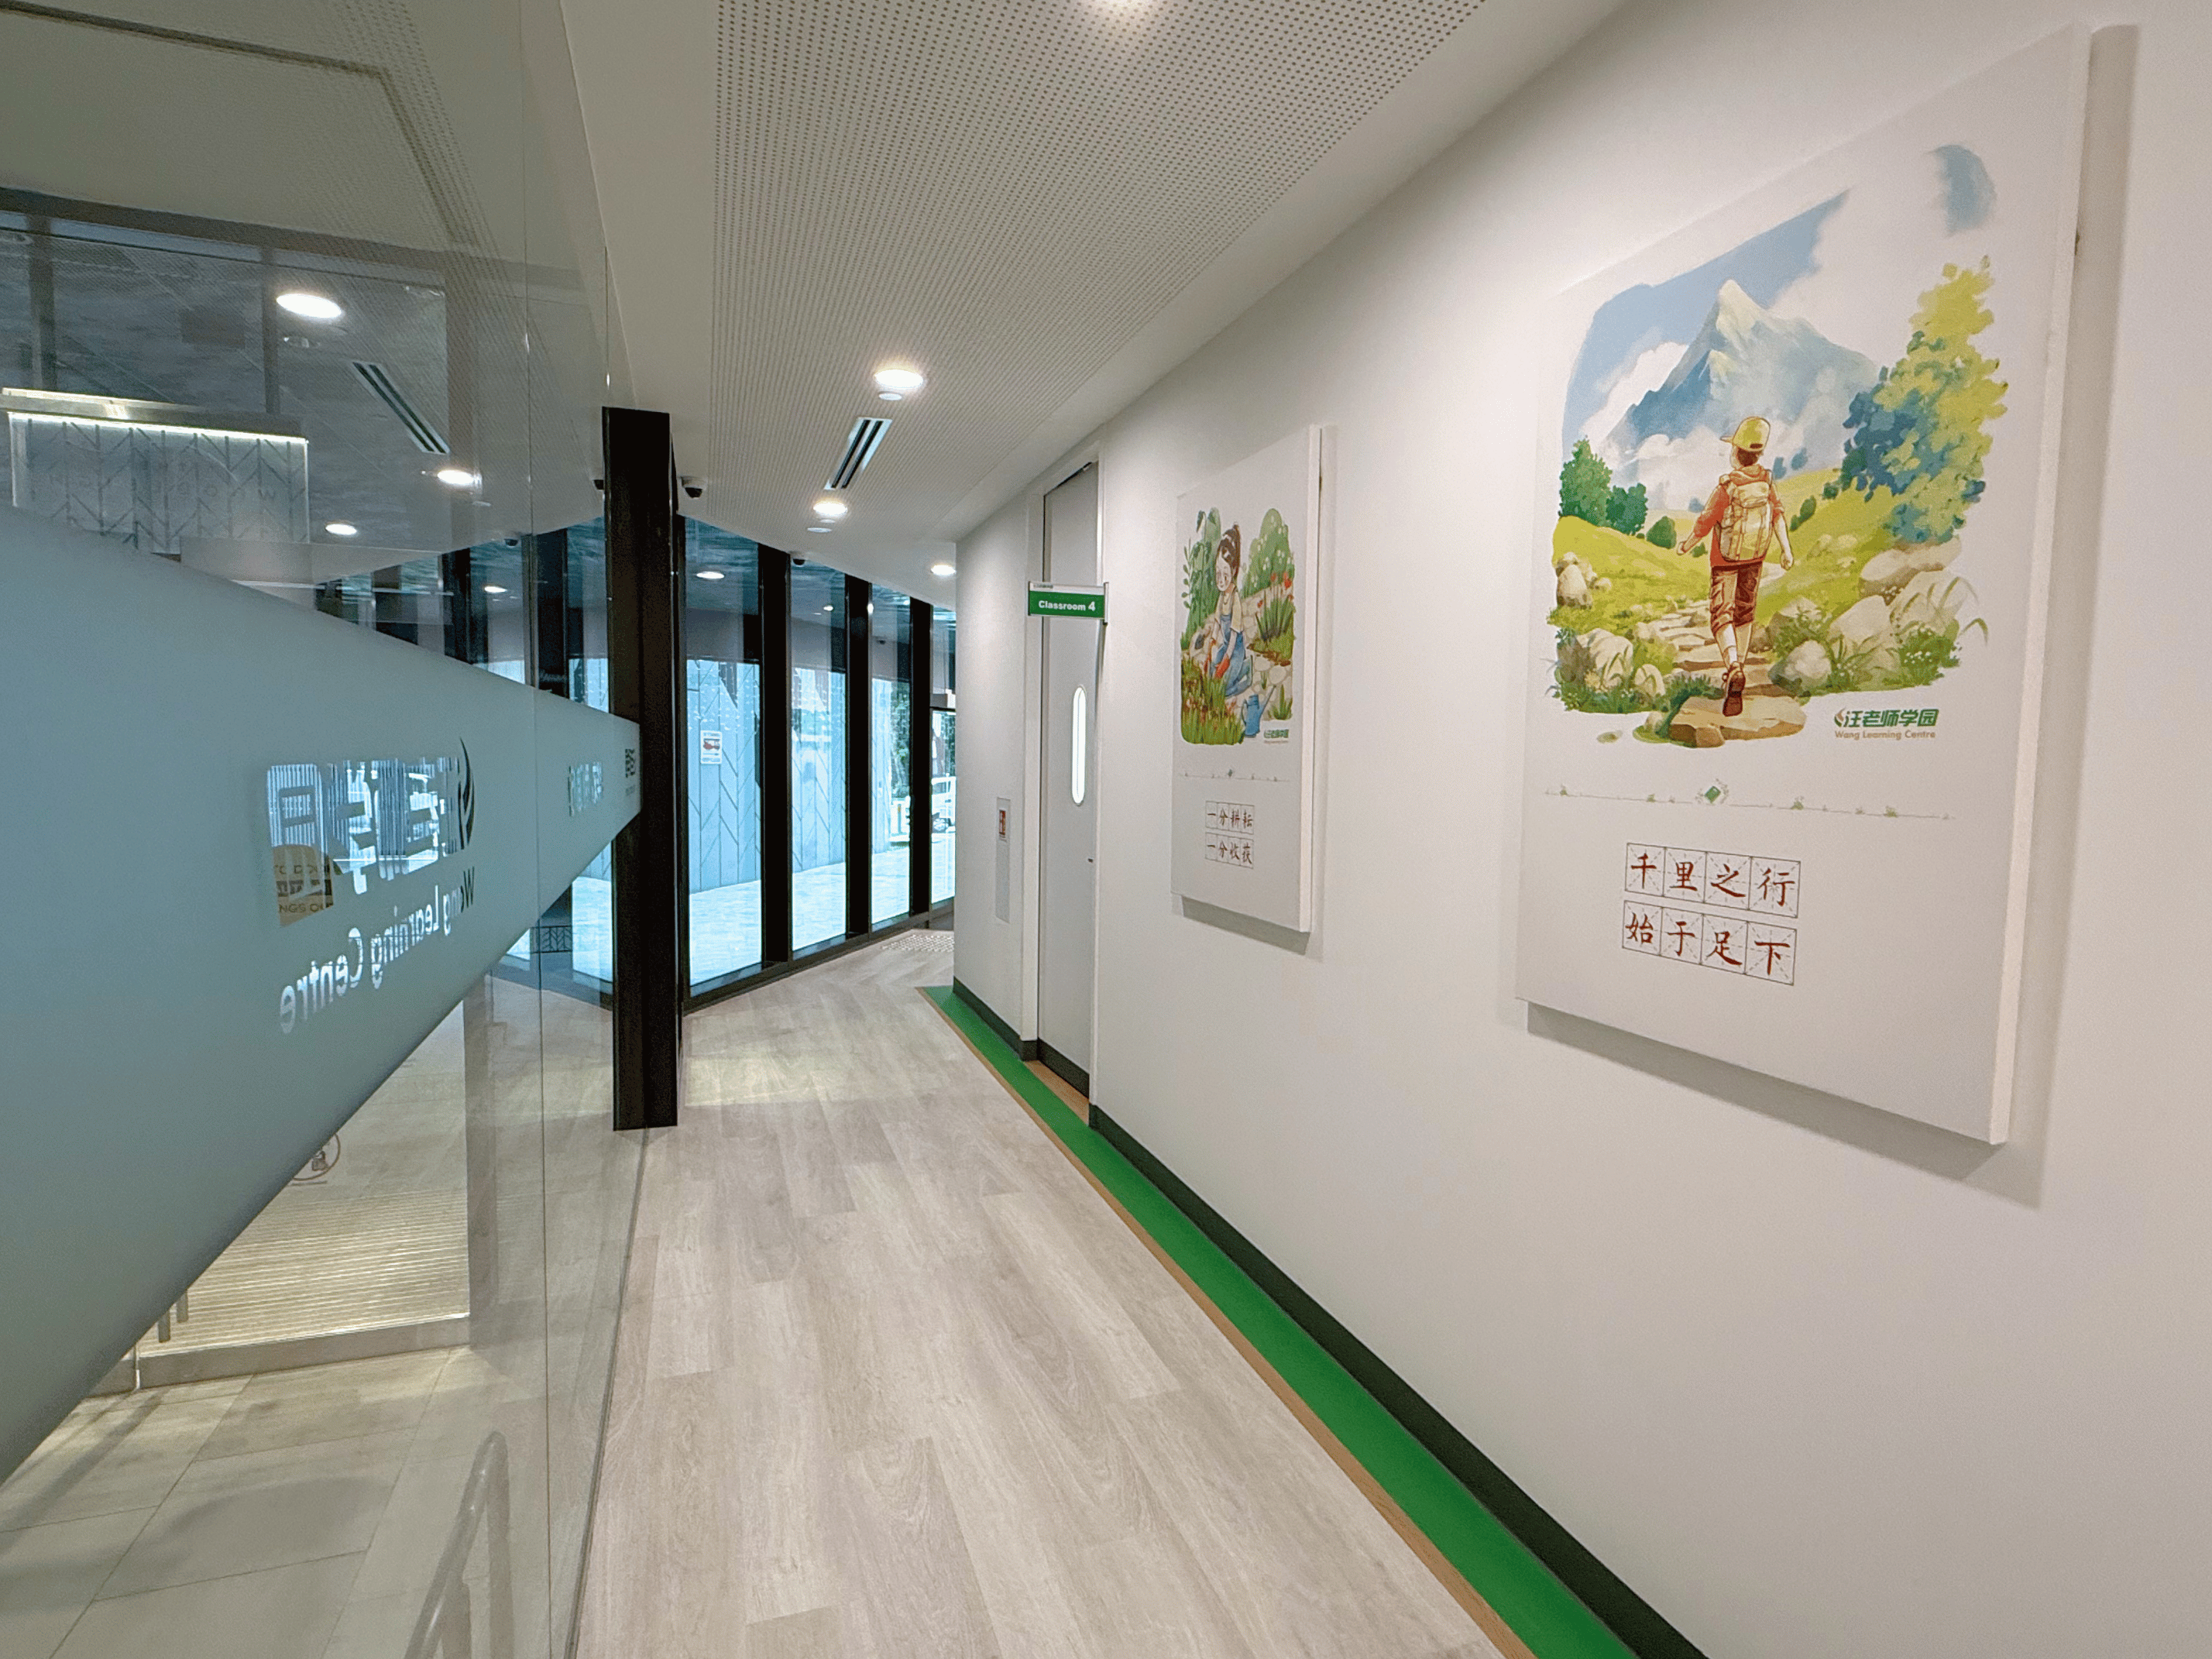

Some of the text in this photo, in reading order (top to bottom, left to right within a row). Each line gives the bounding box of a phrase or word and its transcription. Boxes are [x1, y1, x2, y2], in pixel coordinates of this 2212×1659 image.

[1038, 599, 1096, 611] Classroom 4
[1843, 709, 1939, 728] 汪老师学园
[1835, 730, 1936, 740] Wang Learning Centre
[1207, 807, 1253, 830] 一分耕耘
[1207, 839, 1252, 864] 一分收获
[1630, 853, 1796, 907] 千里之行
[1624, 912, 1791, 976] 始于足下
